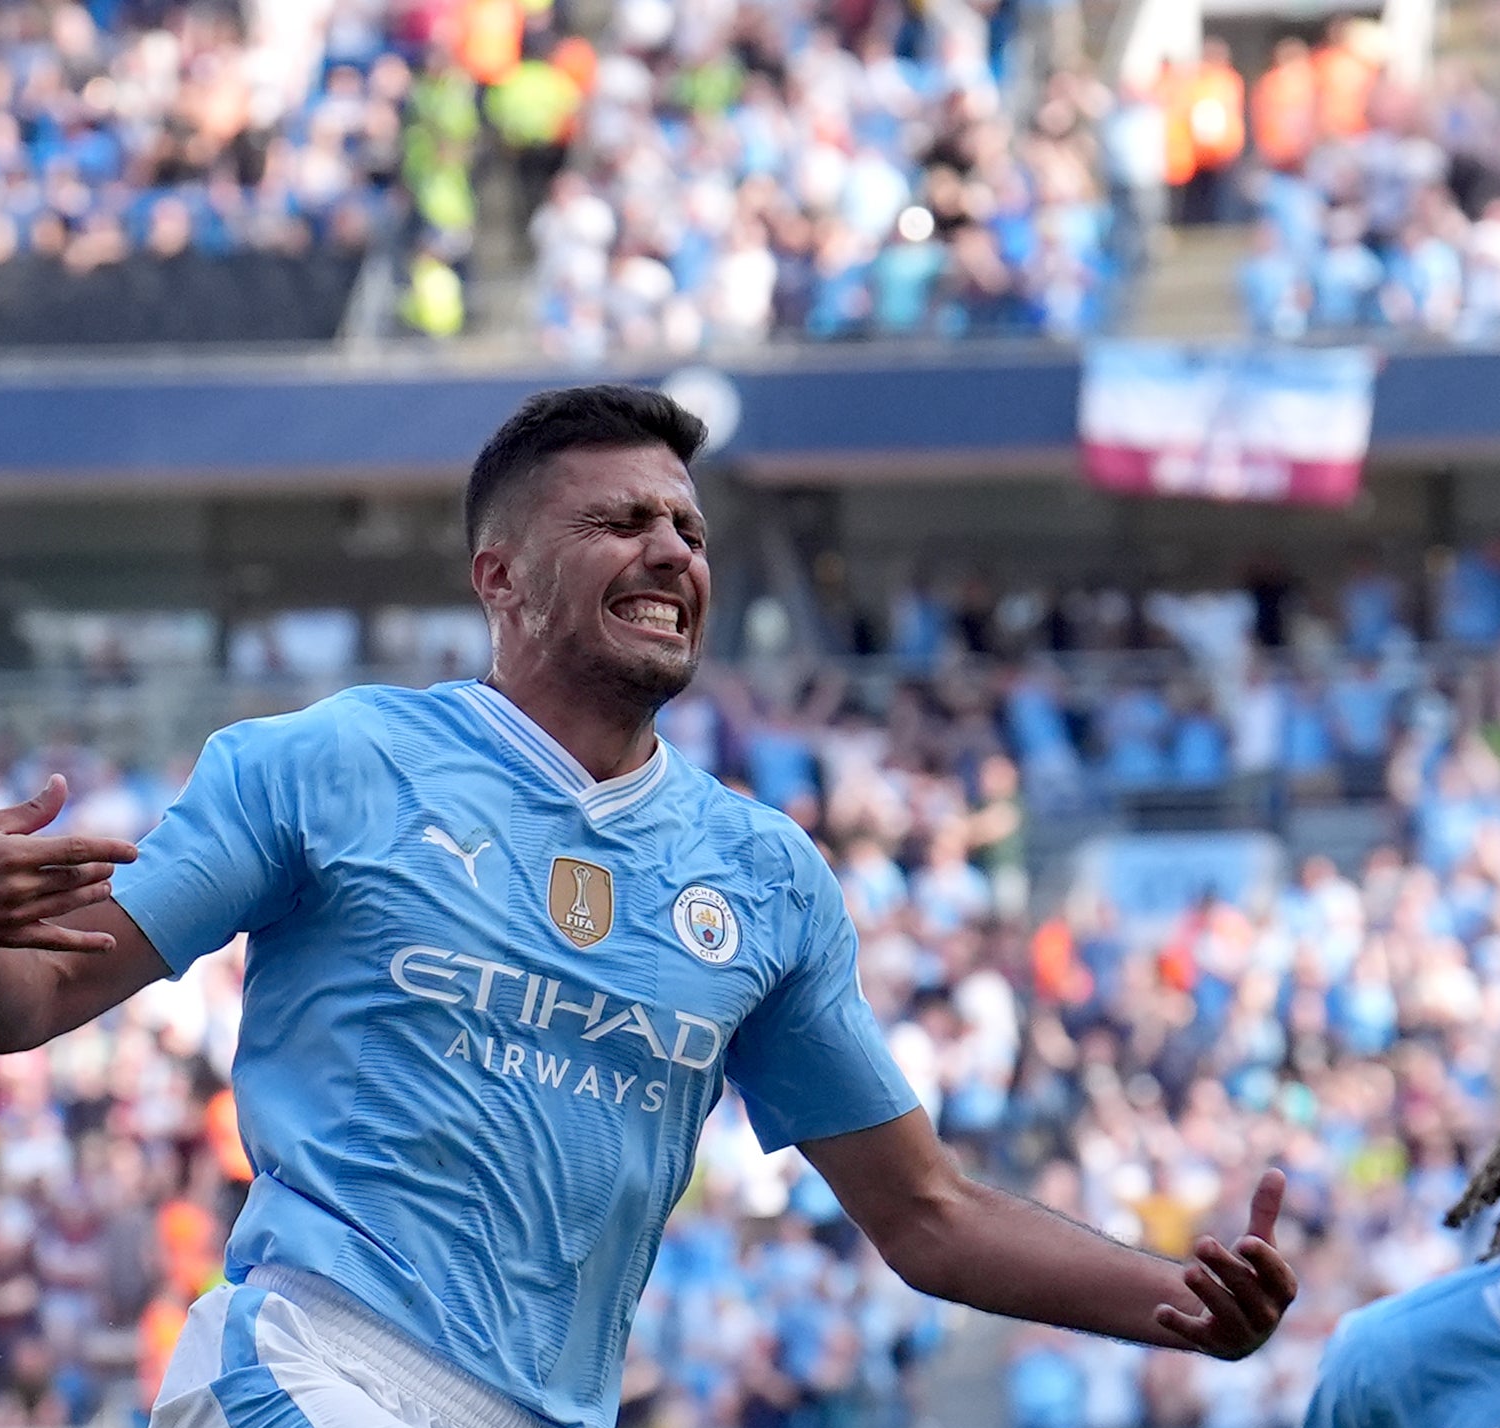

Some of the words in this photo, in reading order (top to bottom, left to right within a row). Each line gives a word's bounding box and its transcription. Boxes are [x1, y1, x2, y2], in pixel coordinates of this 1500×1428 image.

[678, 888, 732, 921] MANCHESTER
[565, 912, 596, 931] FIFA
[699, 949, 720, 960] CITY
[389, 944, 721, 1070] ETIHAD
[443, 1030, 668, 1113] AIRWAYS
